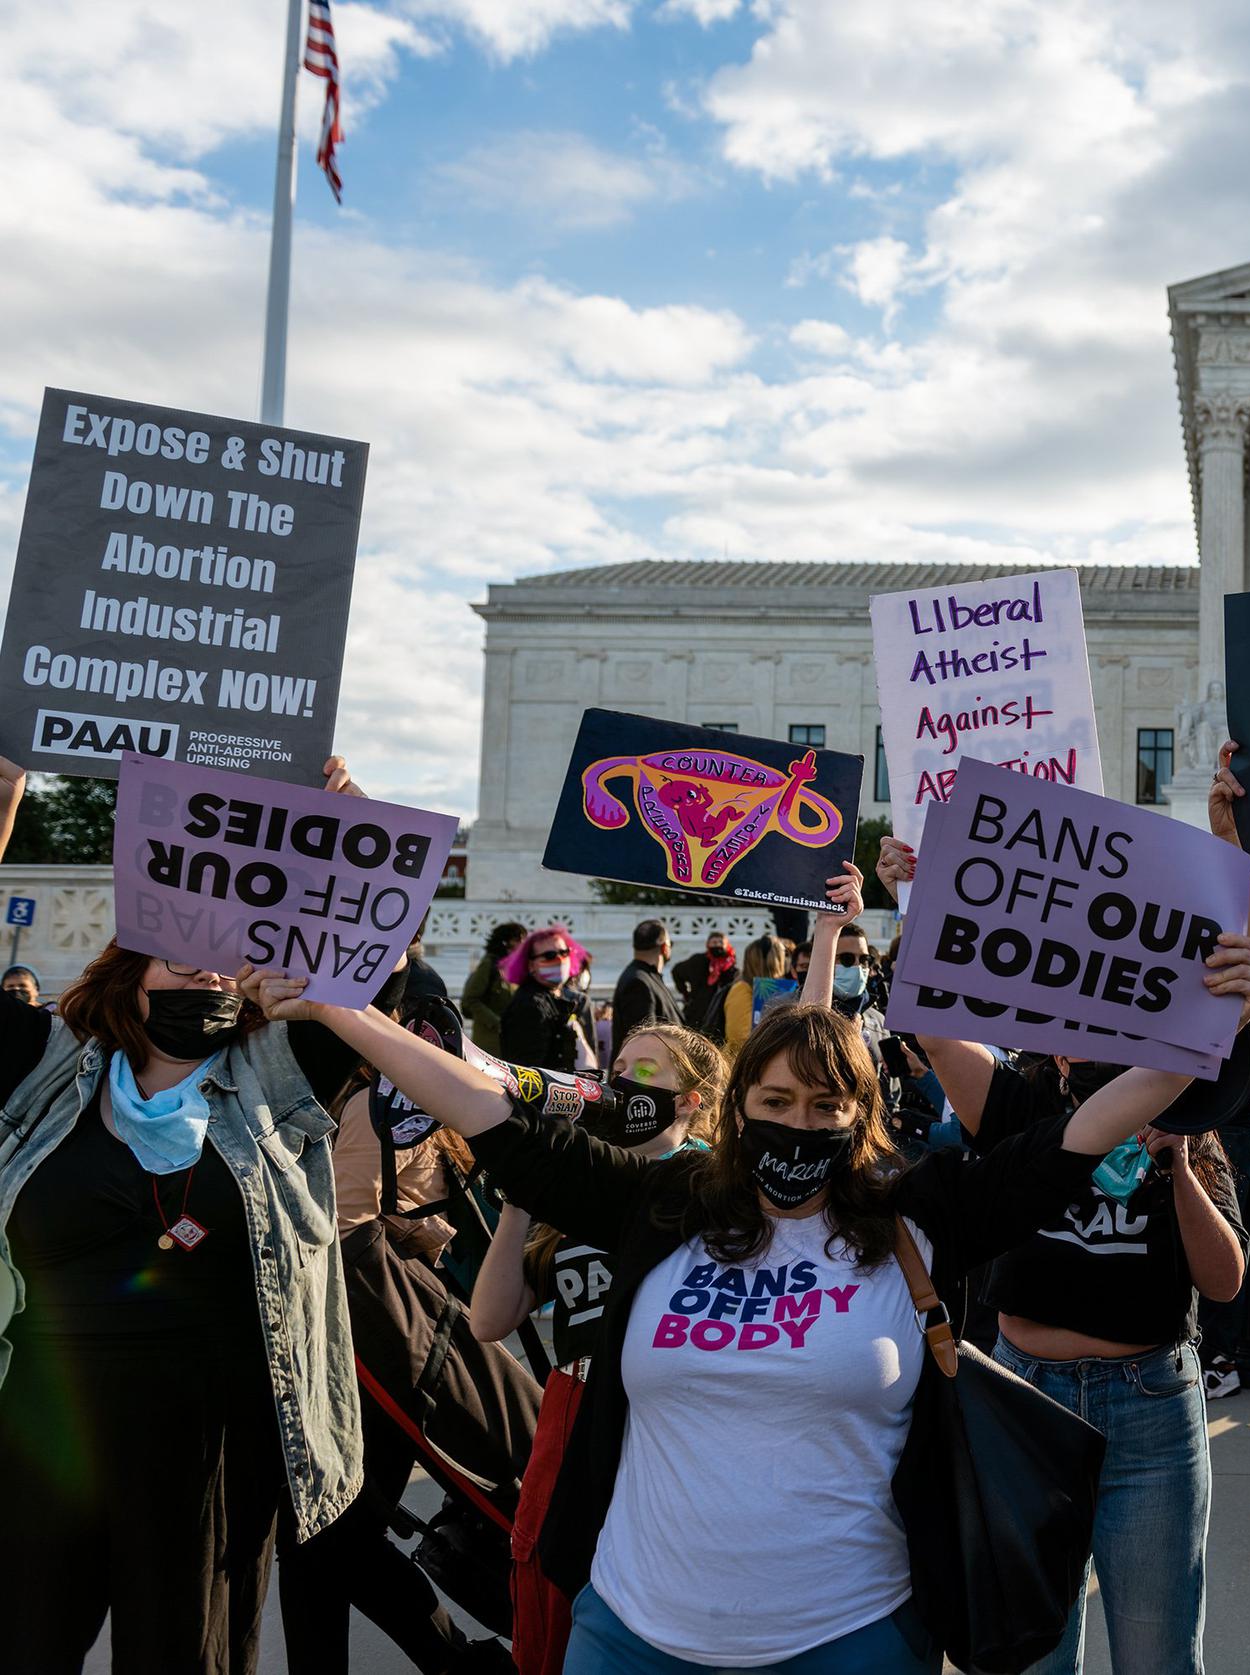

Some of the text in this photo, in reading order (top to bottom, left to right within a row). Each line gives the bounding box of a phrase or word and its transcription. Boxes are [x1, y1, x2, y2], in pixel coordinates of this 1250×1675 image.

[62, 404, 346, 487] Expose & Shut
[100, 471, 294, 537] Down The
[101, 532, 277, 593] Abortion
[80, 589, 281, 653] Industrial
[23, 645, 317, 717] Complex NOW!
[909, 638, 1047, 685] Atheist
[40, 717, 172, 758] PAAU
[189, 731, 282, 750] PROGRESSIVE
[916, 695, 1053, 755] Against
[186, 754, 250, 770] UPRISING
[187, 742, 292, 763] ANTI-ABORTION
[661, 755, 767, 786] COUNTER
[184, 793, 432, 879] BODIES
[706, 804, 772, 882] VIOLENCE
[968, 793, 1134, 879] BANS
[147, 839, 410, 932] OFF OUR
[734, 887, 845, 913] @TakeFeminismBack
[954, 857, 1224, 963] OFF OUR
[244, 919, 390, 984] BANS
[934, 914, 1179, 1013] BODIES
[553, 1090, 578, 1102] STOP
[625, 1120, 658, 1129] COVERED
[758, 1151, 831, 1182] MARCH
[669, 1284, 861, 1323] OFF MY
[682, 1261, 818, 1298] BANS
[652, 1313, 820, 1351] BODY
